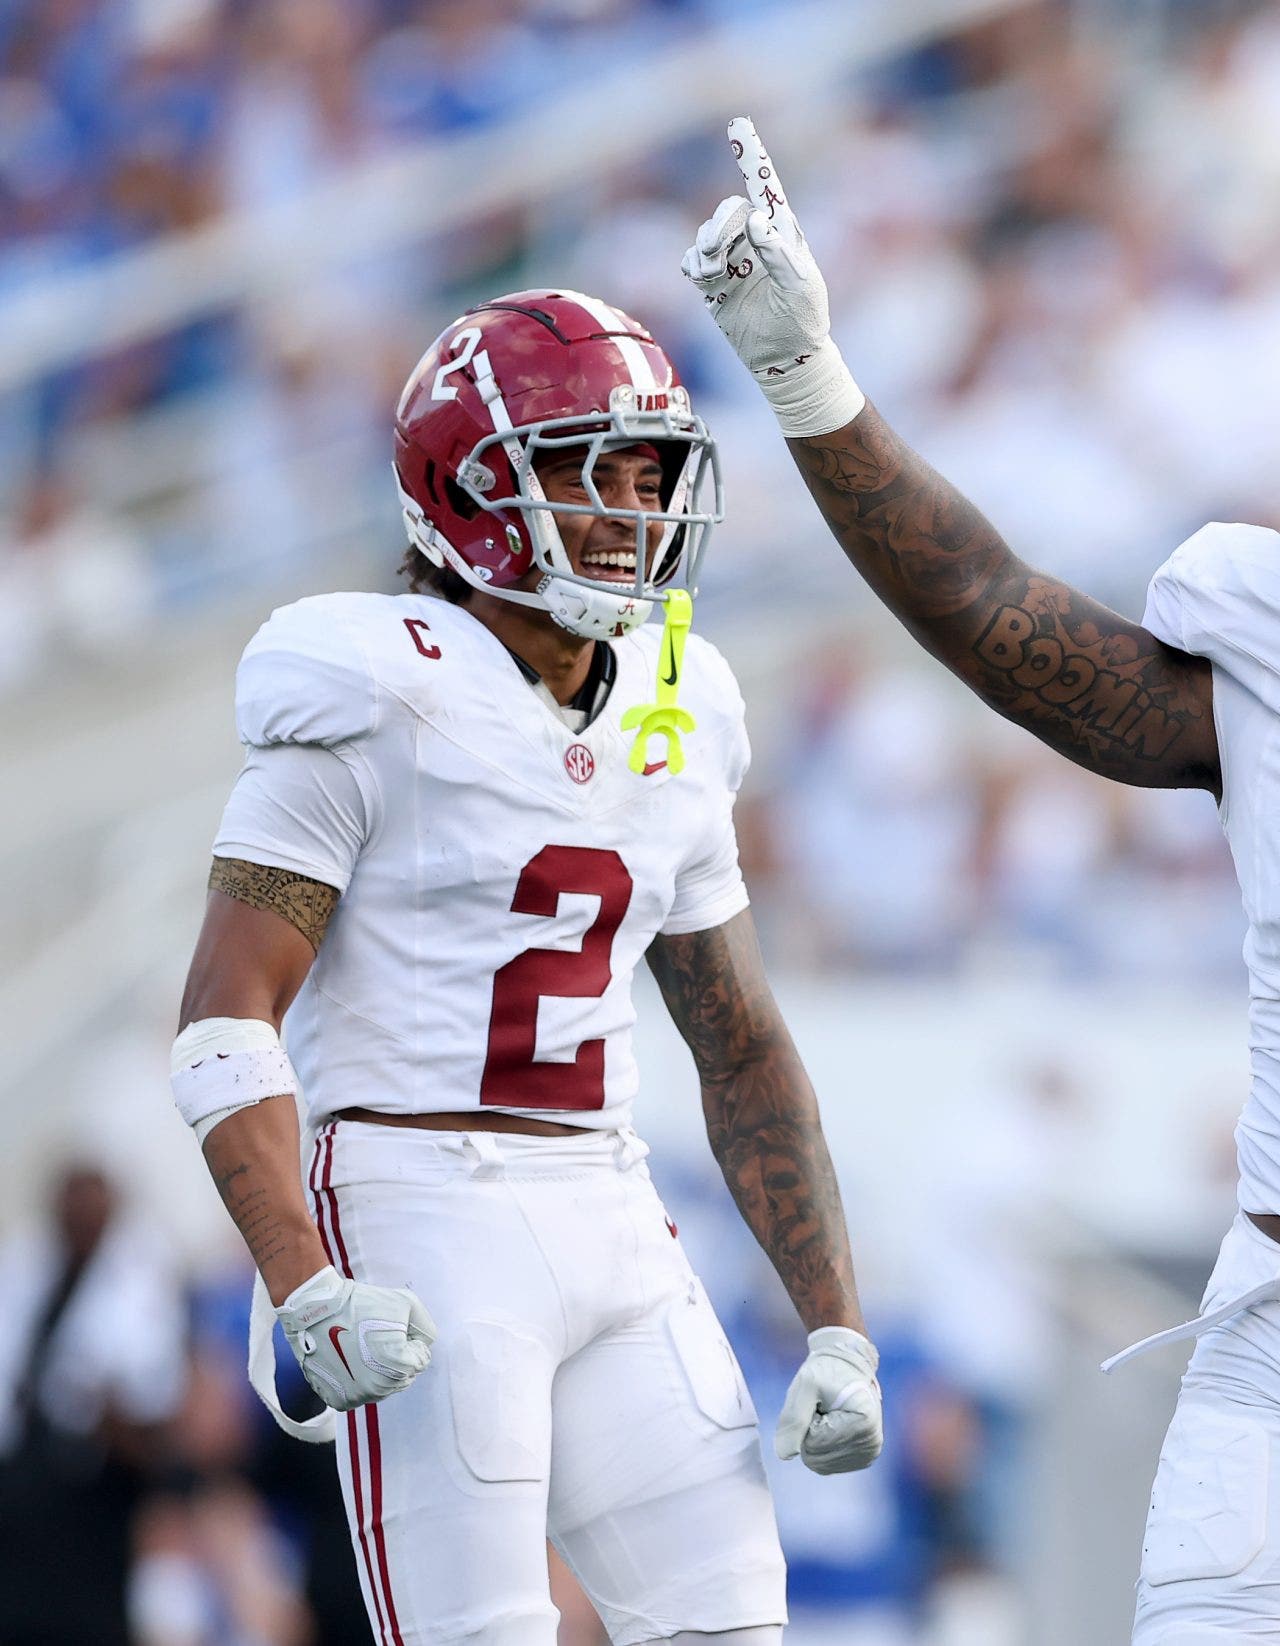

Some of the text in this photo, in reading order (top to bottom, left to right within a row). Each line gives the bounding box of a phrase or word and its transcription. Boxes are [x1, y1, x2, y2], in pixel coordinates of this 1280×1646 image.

[759, 185, 785, 220] A
[431, 327, 483, 401] 2
[617, 598, 635, 616] A
[403, 618, 442, 661] C
[566, 745, 594, 782] SEC
[479, 844, 634, 1111] 2
